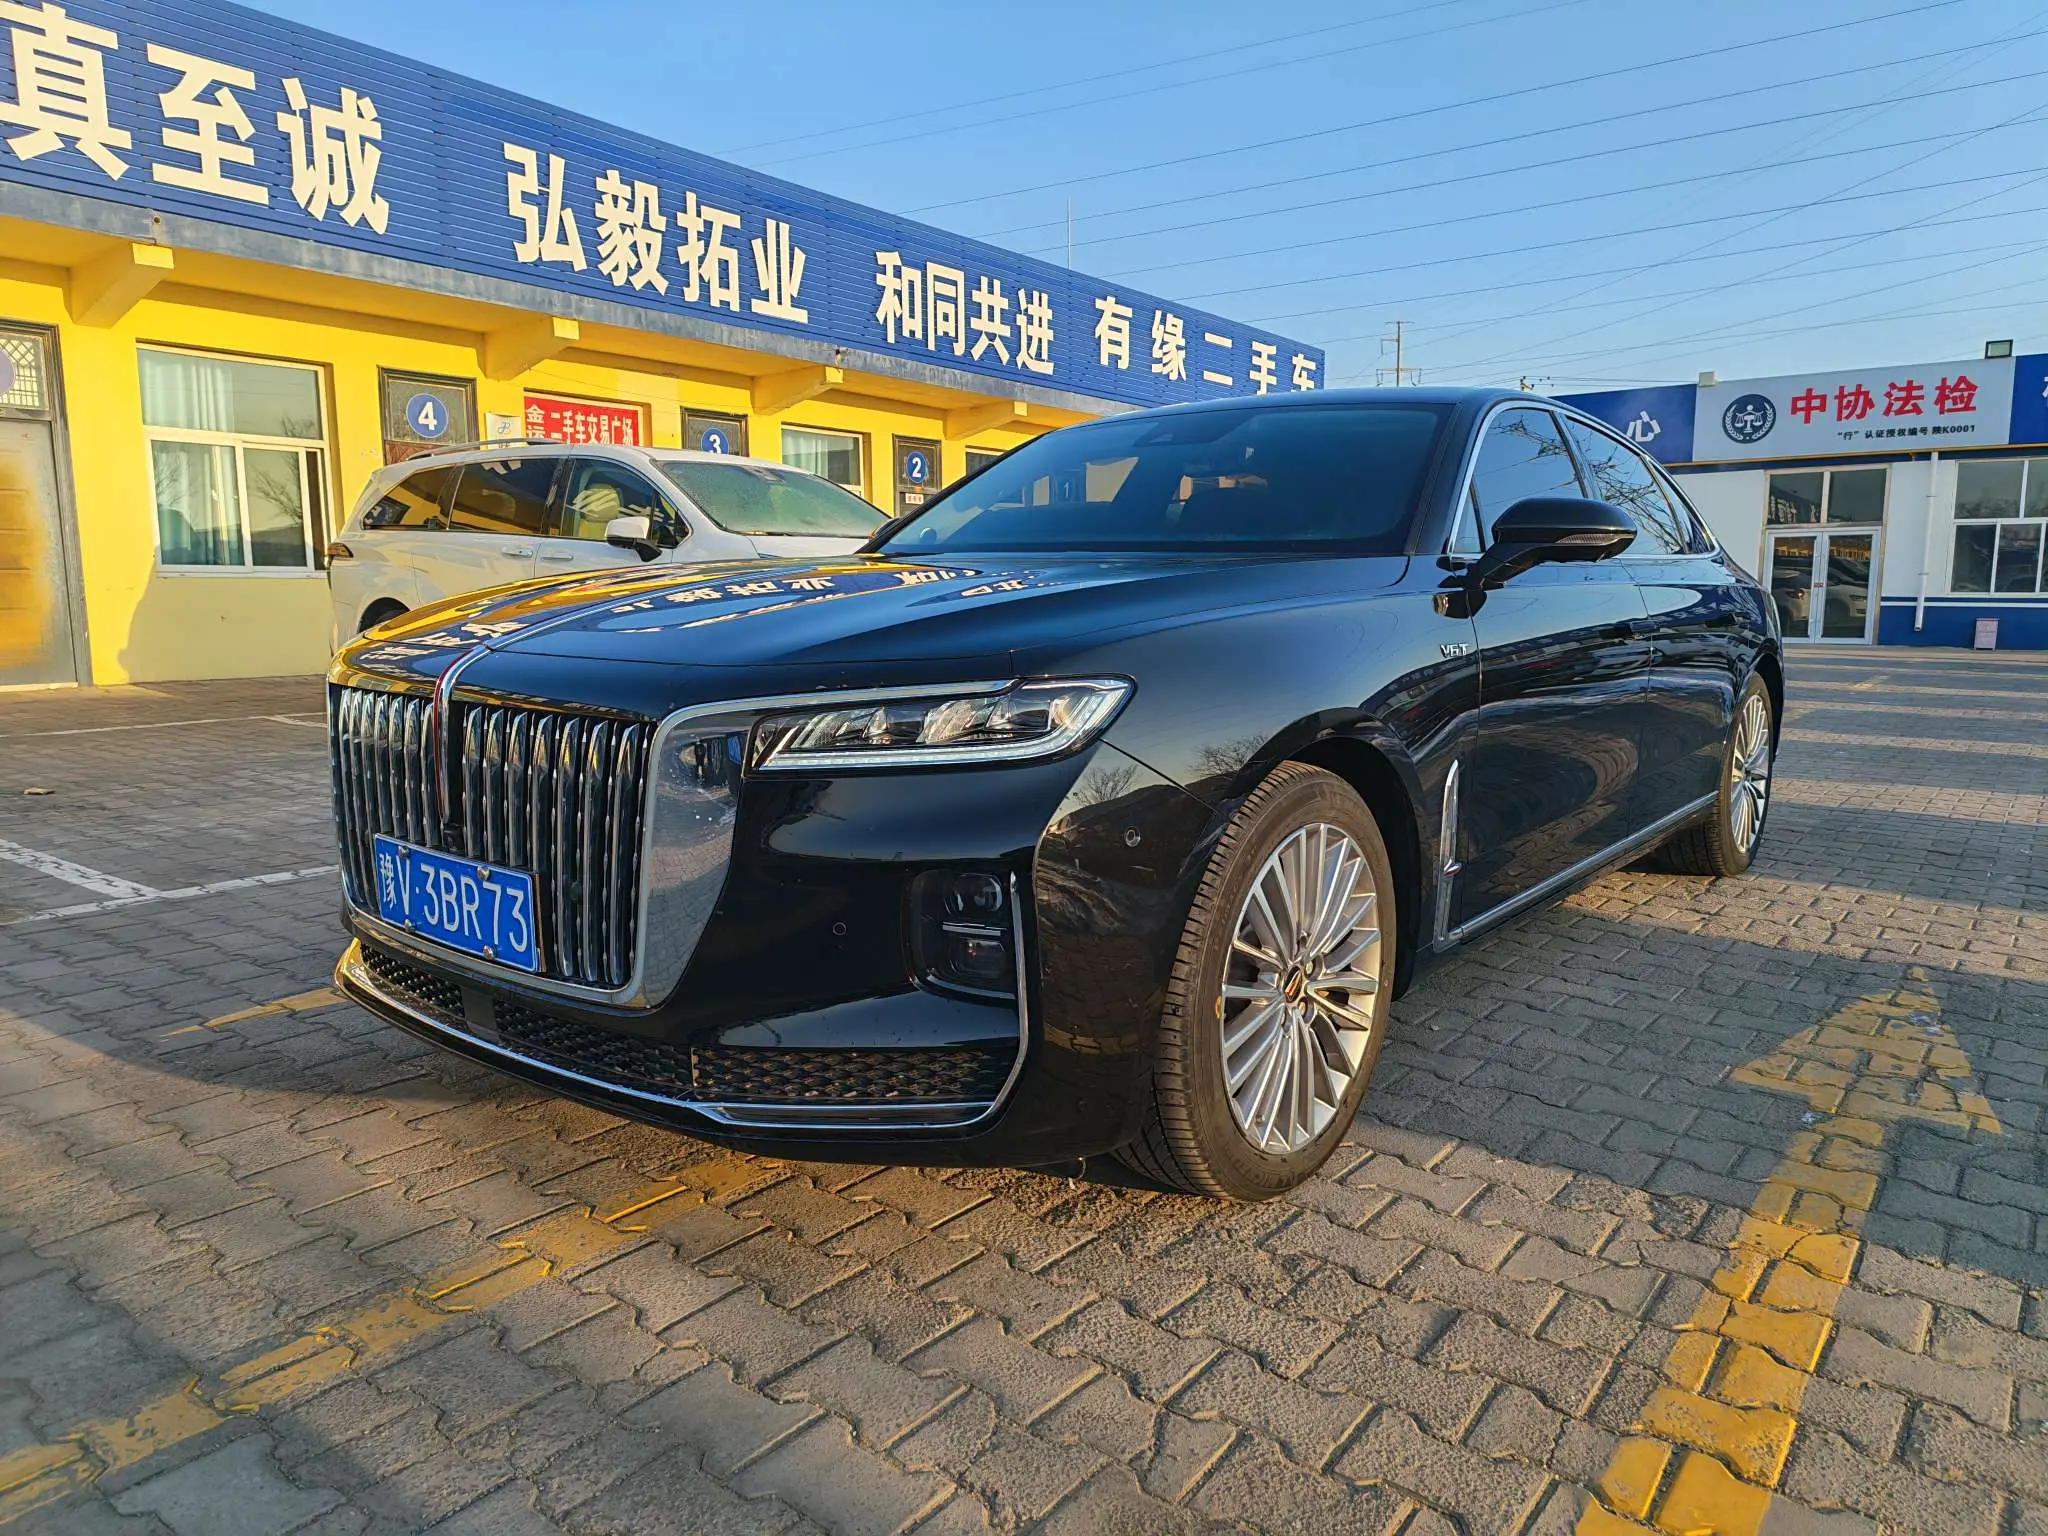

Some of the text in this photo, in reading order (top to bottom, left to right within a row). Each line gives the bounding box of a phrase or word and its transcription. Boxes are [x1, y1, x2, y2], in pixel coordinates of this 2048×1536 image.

[0, 2, 1317, 396] 真至诚 弘毅拓业 和同共进 有缘二手车
[417, 401, 437, 431] 4
[1790, 375, 1978, 424] 中协法检
[550, 409, 634, 446] 二手车交易广场
[708, 433, 722, 454] 3
[912, 457, 922, 478] 2
